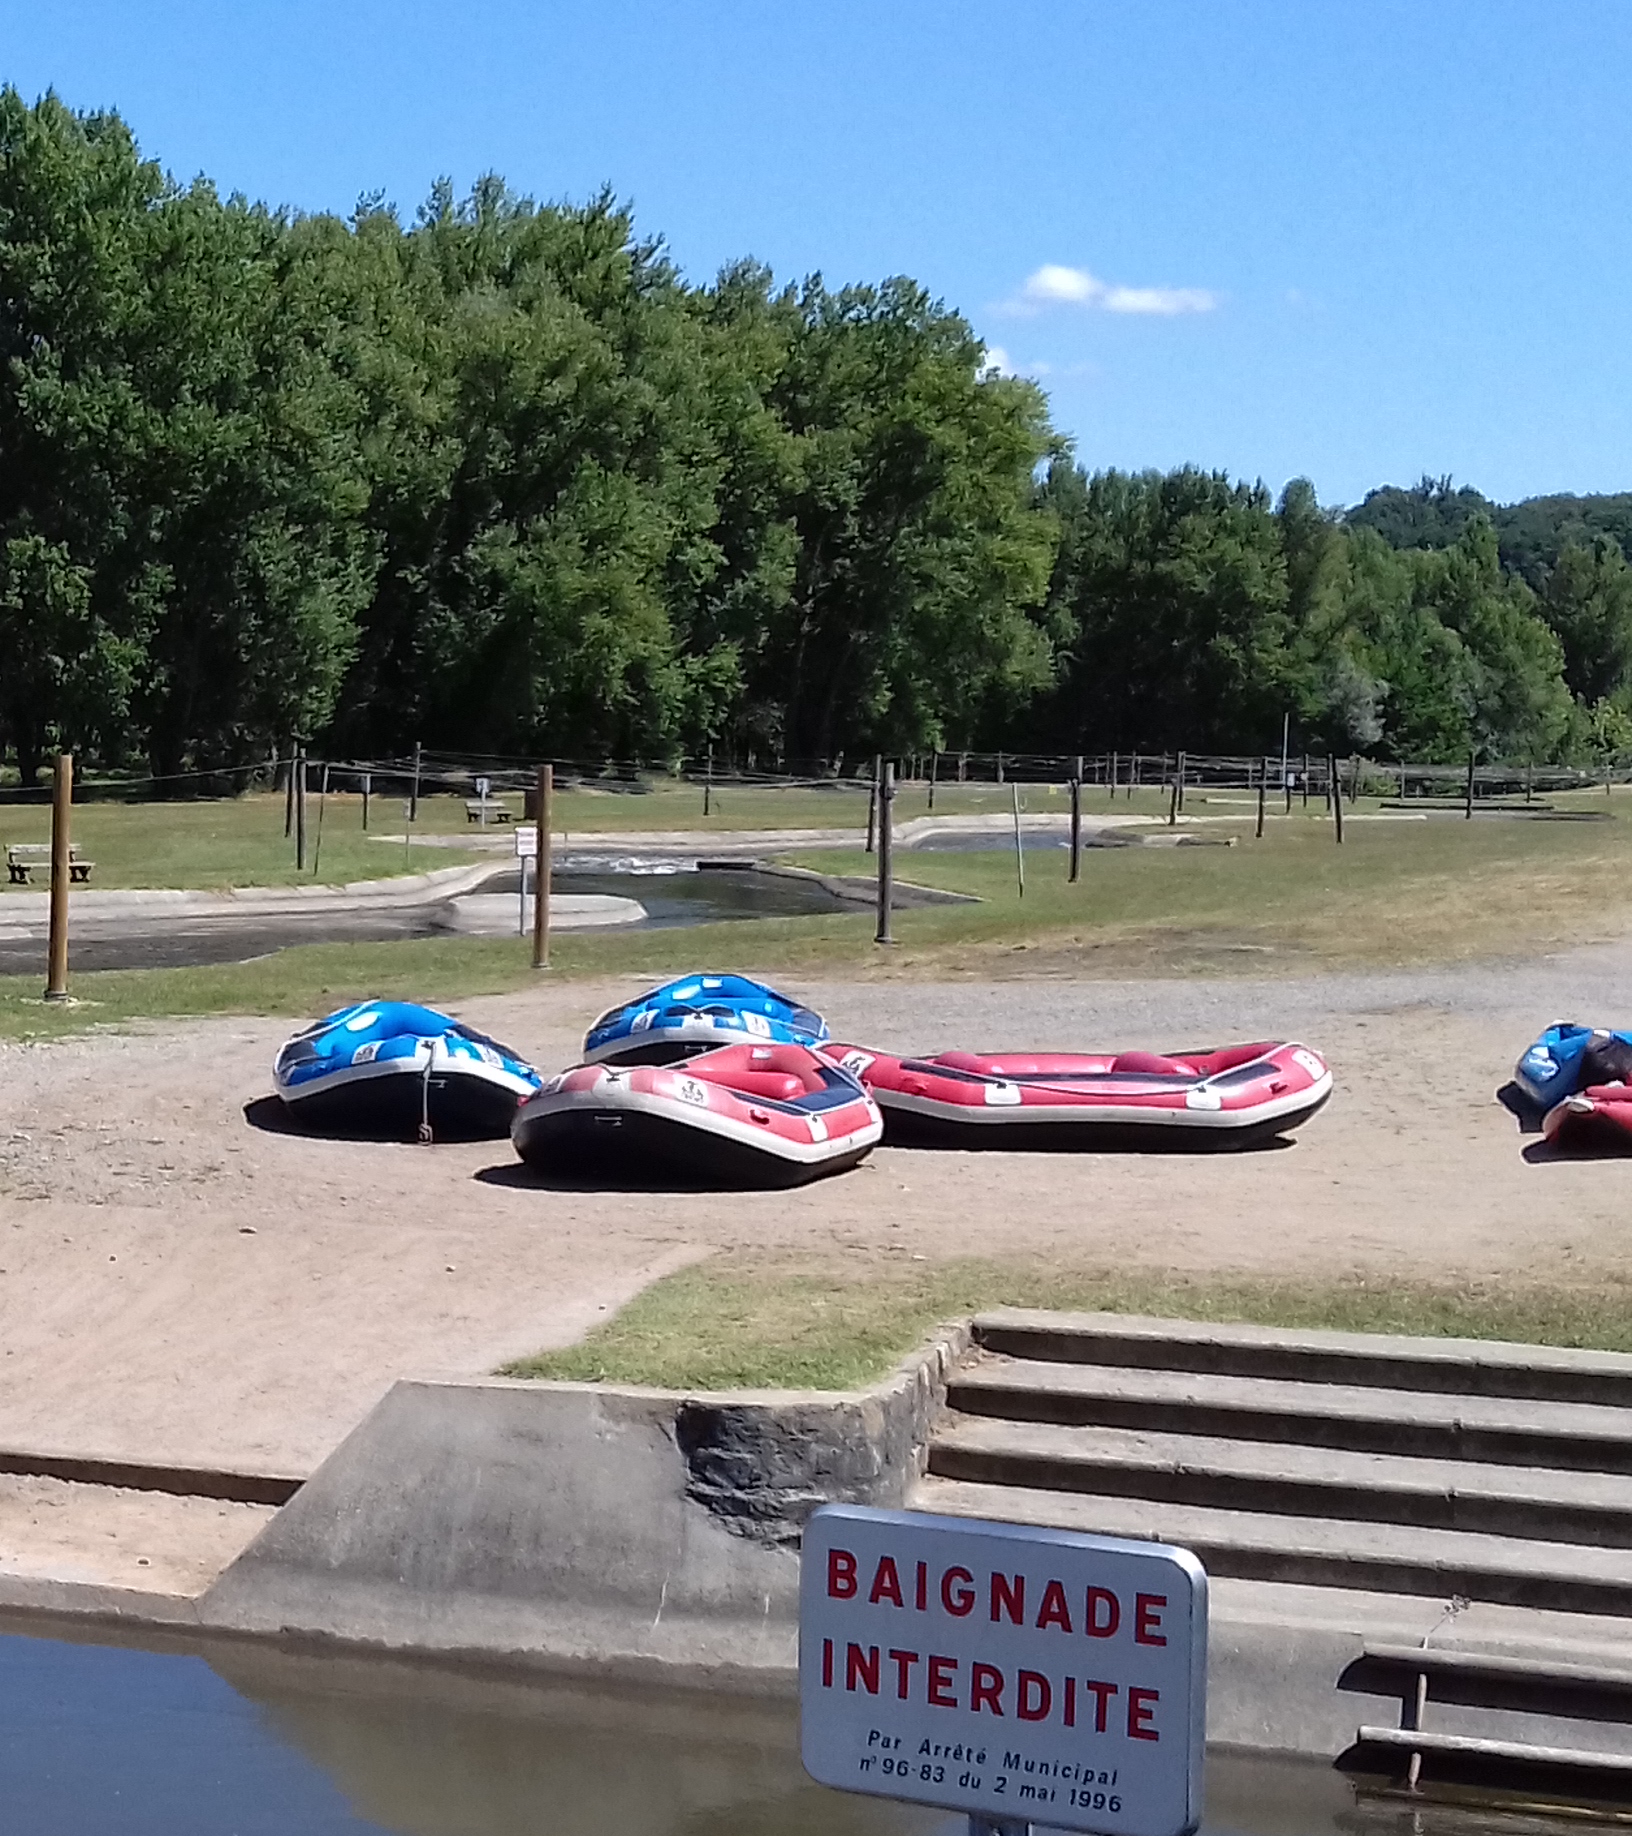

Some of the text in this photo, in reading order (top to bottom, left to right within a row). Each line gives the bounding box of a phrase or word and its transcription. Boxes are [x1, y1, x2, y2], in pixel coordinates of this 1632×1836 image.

[827, 1548, 1168, 1647] BAIGNADE
[822, 1638, 1160, 1742] INTERDITE
[867, 1729, 1118, 1787] Par Arrêté Municipal
[959, 1771, 981, 1790] du
[993, 1776, 1008, 1794] 2
[1019, 1782, 1056, 1803] mai
[1069, 1788, 1123, 1813] 1996
